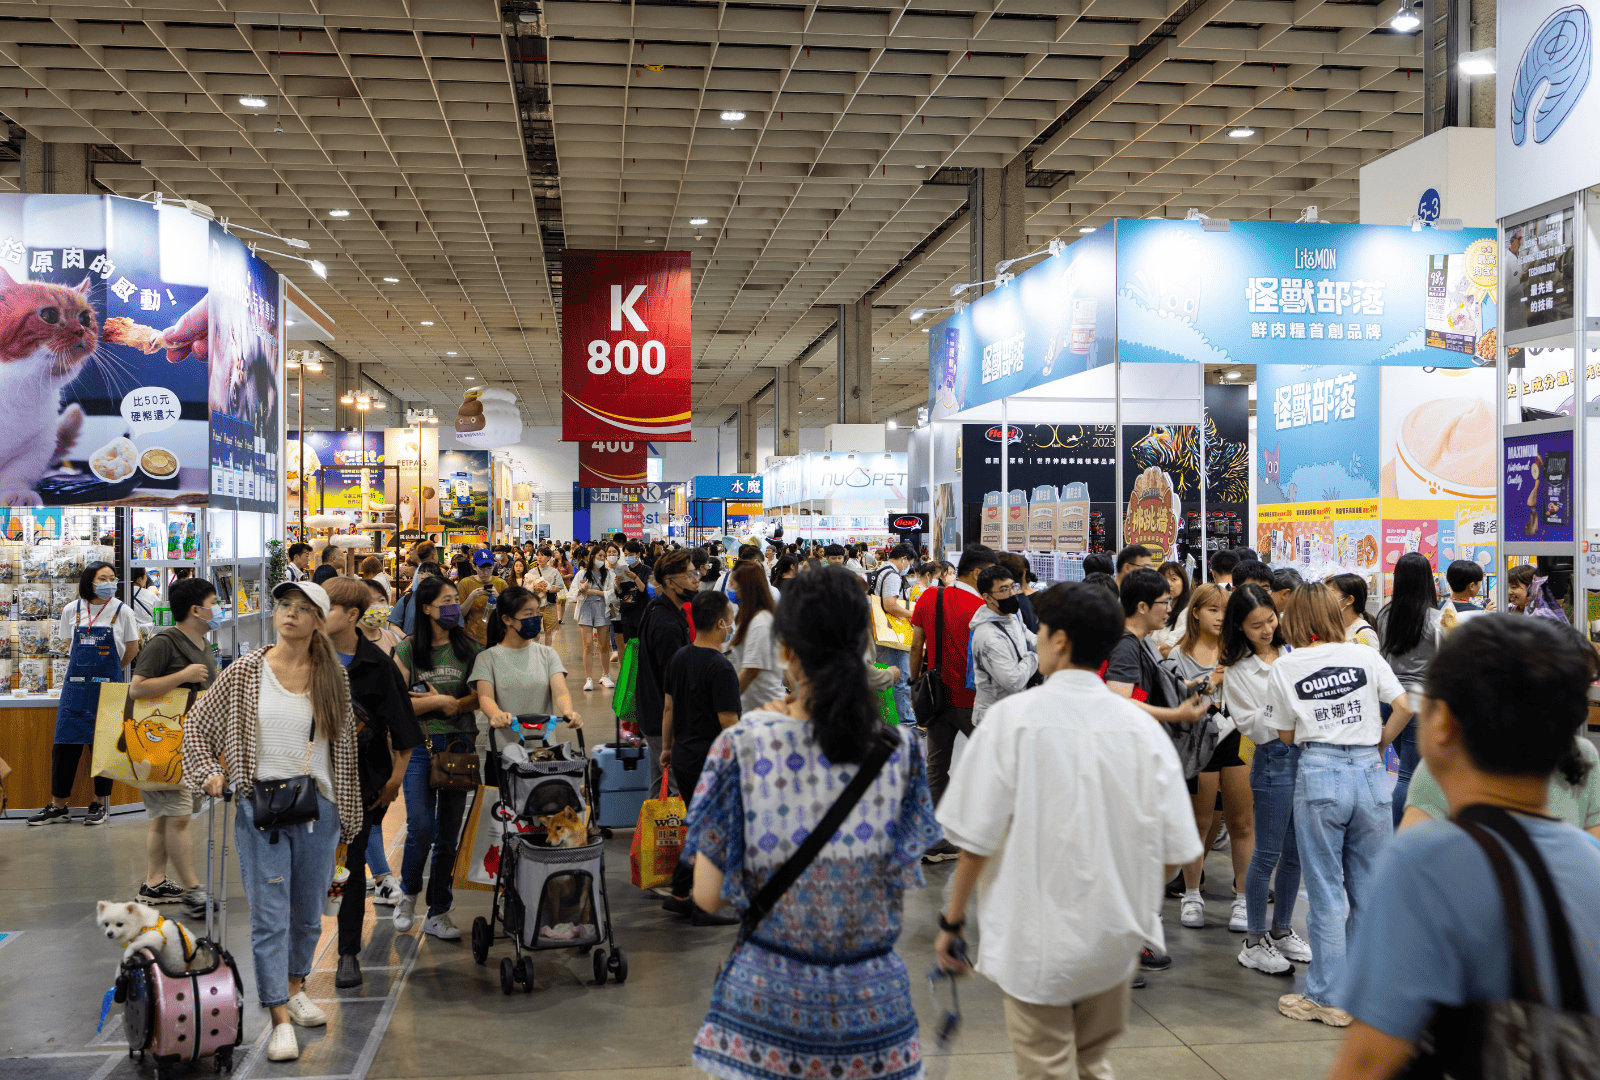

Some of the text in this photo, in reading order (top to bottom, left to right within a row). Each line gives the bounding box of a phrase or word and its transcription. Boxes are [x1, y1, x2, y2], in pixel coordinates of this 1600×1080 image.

[1420, 197, 1439, 221] 5-3
[1528, 261, 1556, 277] TECHNOLOGY
[1245, 277, 1386, 316] 怪獸部落
[1530, 297, 1554, 313] 的技術
[610, 284, 649, 331] K
[1251, 321, 1382, 340] 鮮肉糧首創品牌
[587, 339, 666, 375] 800
[133, 394, 170, 407] 比50元
[1273, 371, 1358, 431] 怪獸部落
[1092, 437, 1116, 448] 2023
[1508, 444, 1538, 459] MAXIMUM
[646, 486, 658, 500] K
[1301, 668, 1359, 693] ownat
[1314, 699, 1362, 721] 歐娜特
